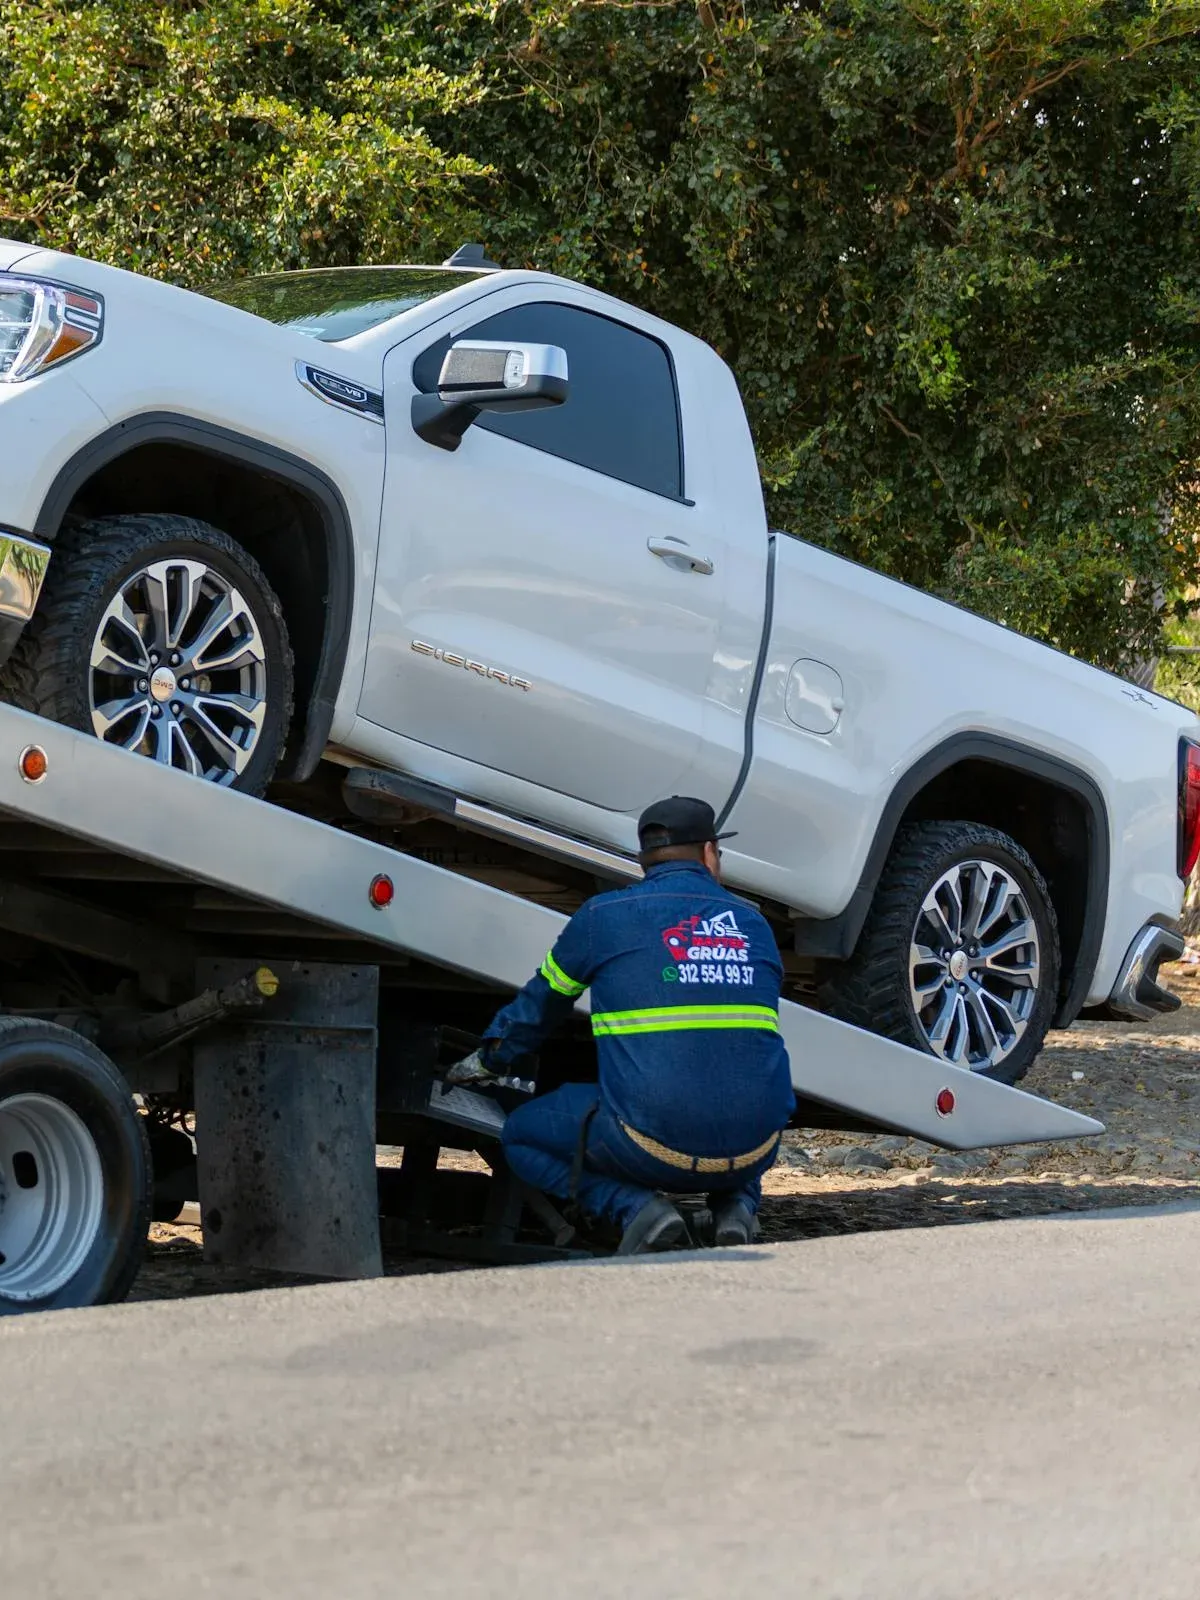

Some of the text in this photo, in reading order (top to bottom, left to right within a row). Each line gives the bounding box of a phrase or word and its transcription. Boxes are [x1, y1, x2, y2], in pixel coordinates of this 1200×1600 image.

[411, 639, 532, 691] SIERRA
[701, 920, 726, 937] VS
[687, 943, 749, 962] GRÚAS
[678, 964, 755, 985] 312 554 99 37
